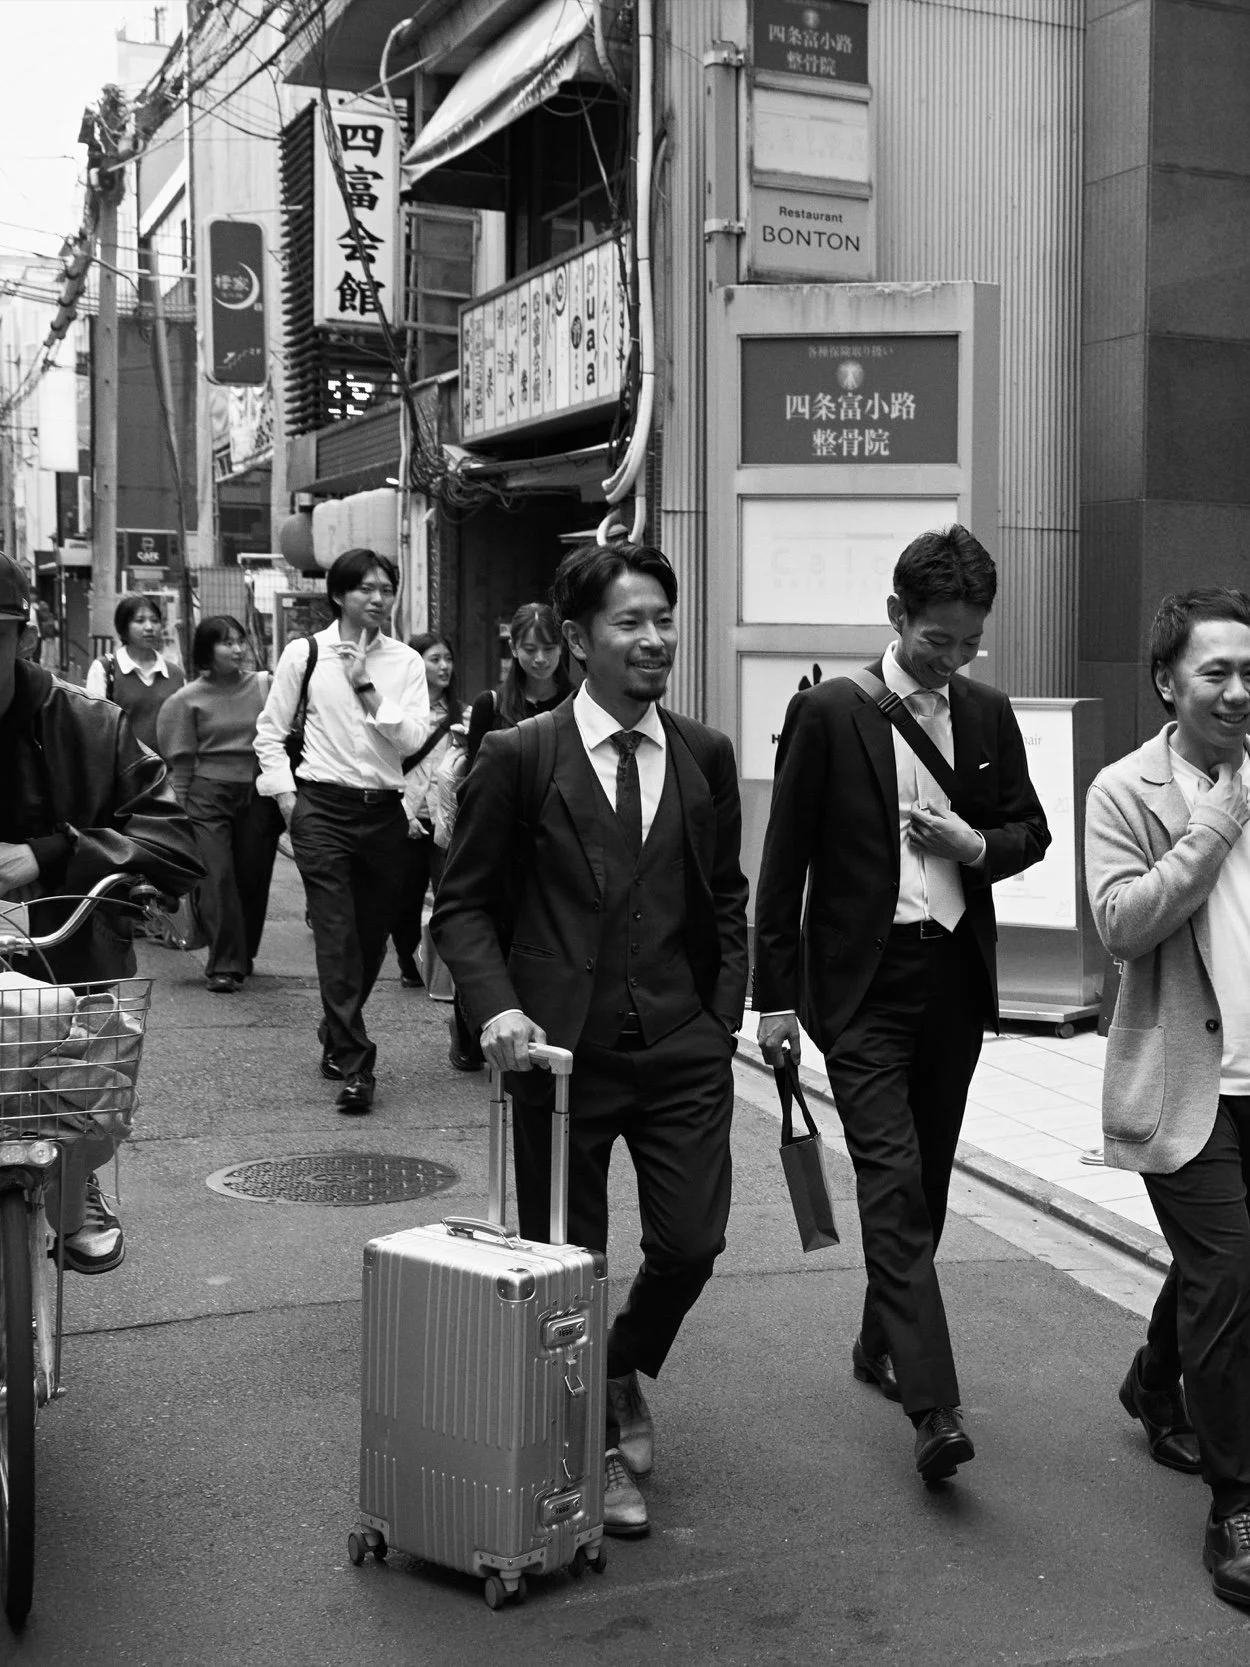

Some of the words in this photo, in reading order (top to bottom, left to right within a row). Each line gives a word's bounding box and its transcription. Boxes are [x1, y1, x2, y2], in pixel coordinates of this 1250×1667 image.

[768, 23, 853, 54] 四条富小路
[335, 124, 386, 316] 四富会館
[779, 206, 843, 223] Restaurant
[762, 225, 860, 252] BONTON
[785, 391, 916, 421] 四条富小路
[811, 428, 890, 456] 整骨院
